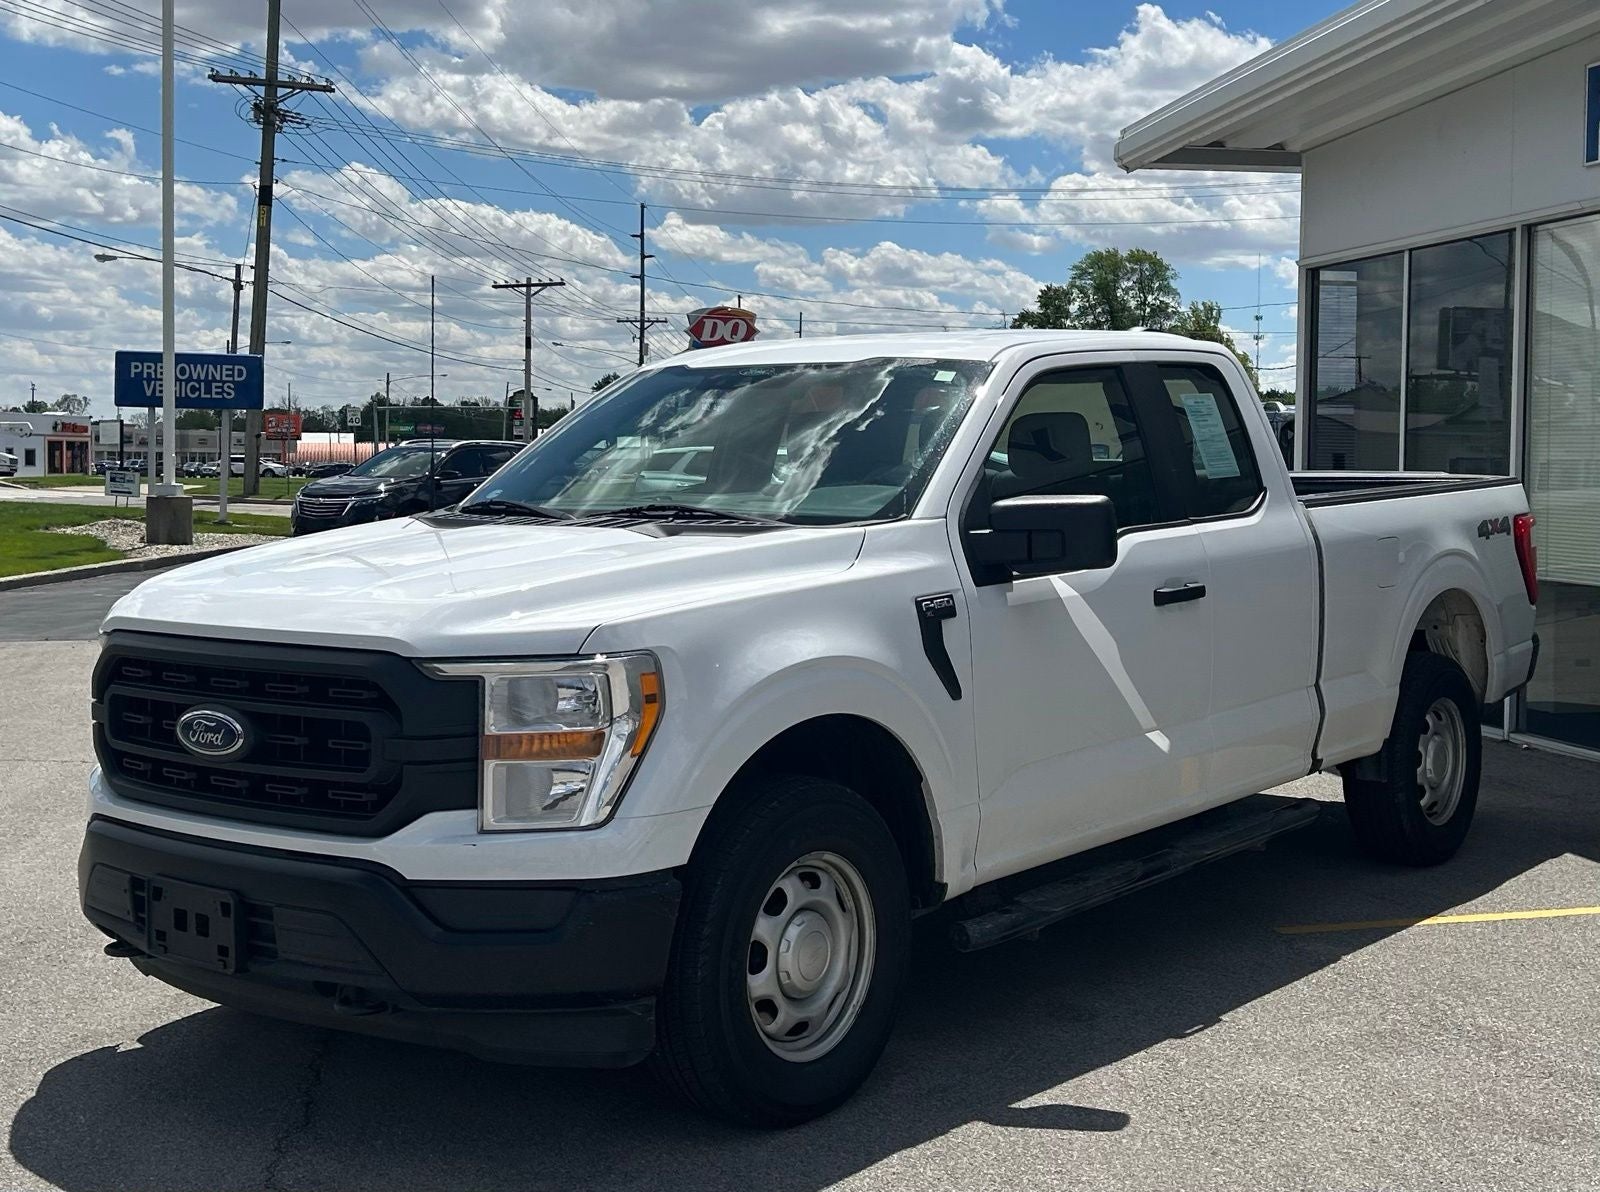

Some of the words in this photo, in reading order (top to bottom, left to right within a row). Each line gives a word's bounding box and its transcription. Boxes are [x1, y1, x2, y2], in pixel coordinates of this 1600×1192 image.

[700, 318, 747, 342] DQ
[348, 417, 360, 425] 40
[189, 719, 225, 746] Ford
